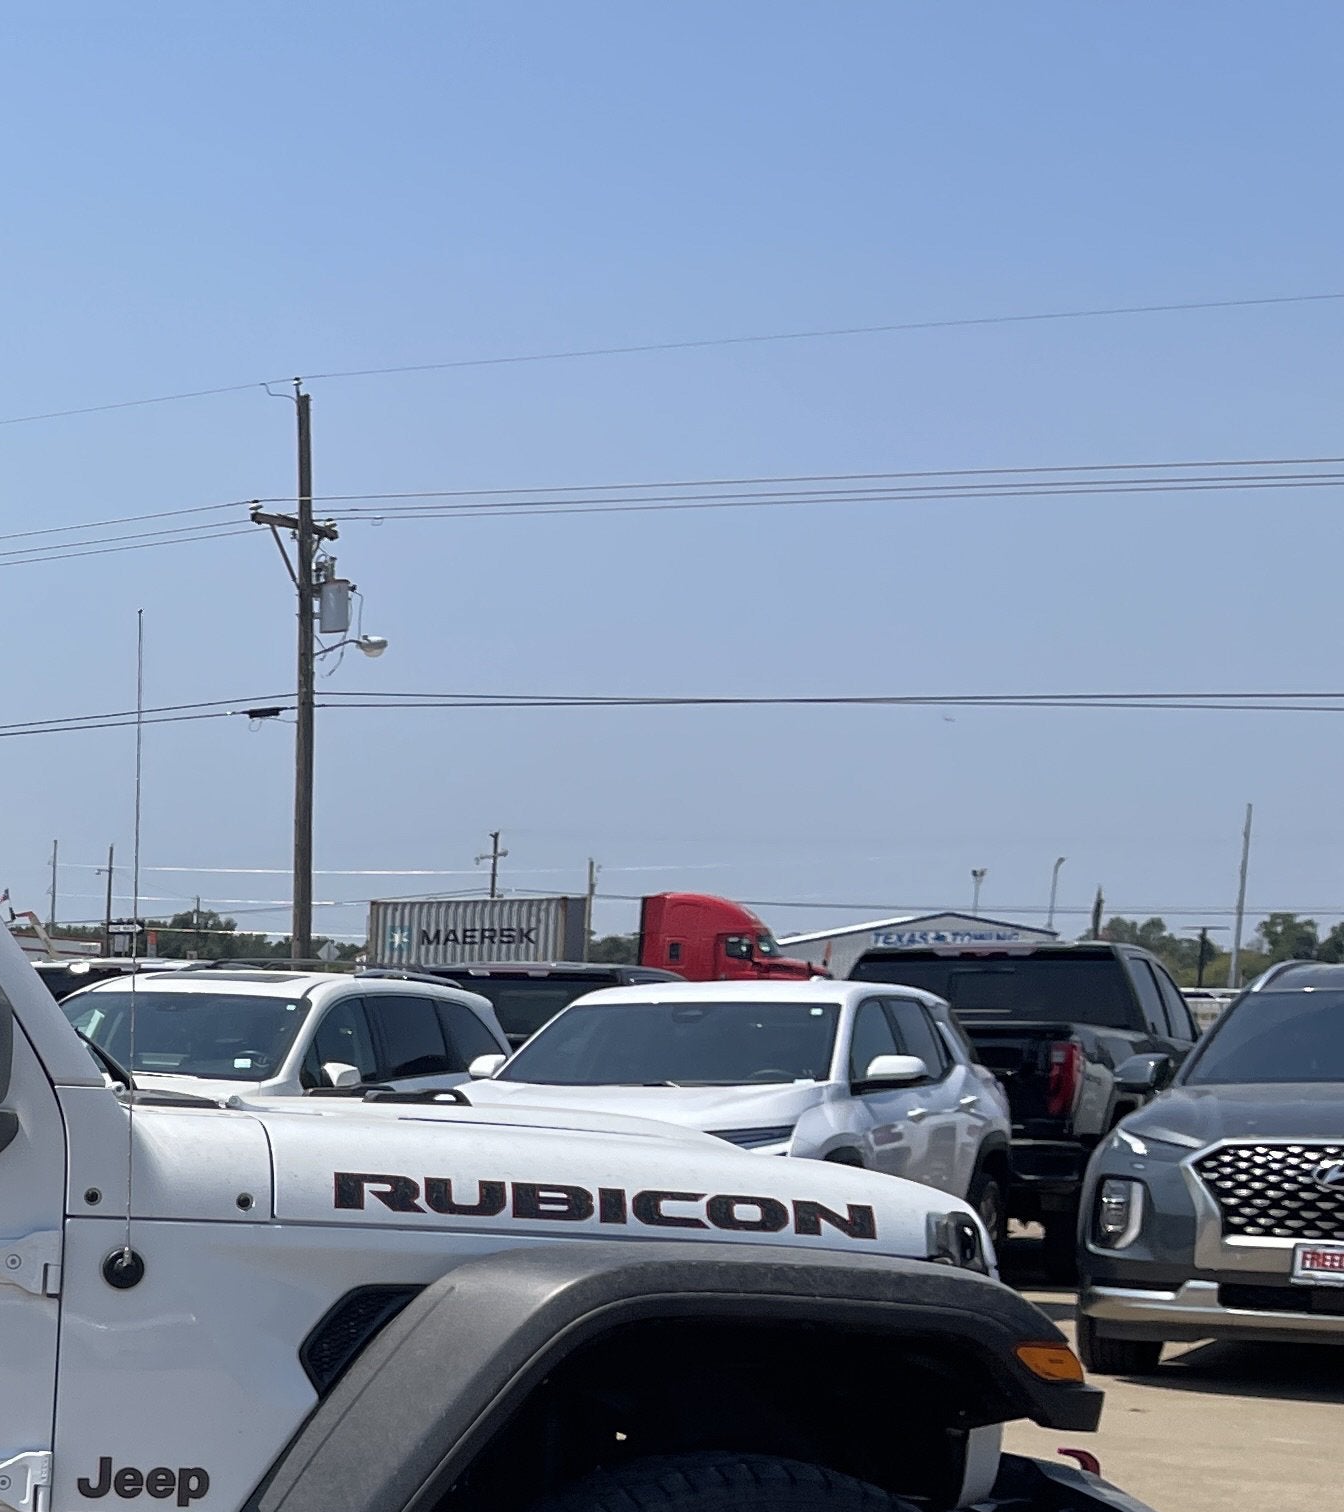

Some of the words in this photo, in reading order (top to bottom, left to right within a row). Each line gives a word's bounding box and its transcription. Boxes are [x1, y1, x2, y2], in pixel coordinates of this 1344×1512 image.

[421, 927, 537, 945] MAERSK
[872, 931, 929, 947] TEXAS
[333, 1171, 878, 1240] RUBICON
[77, 1456, 210, 1507] Jeep
